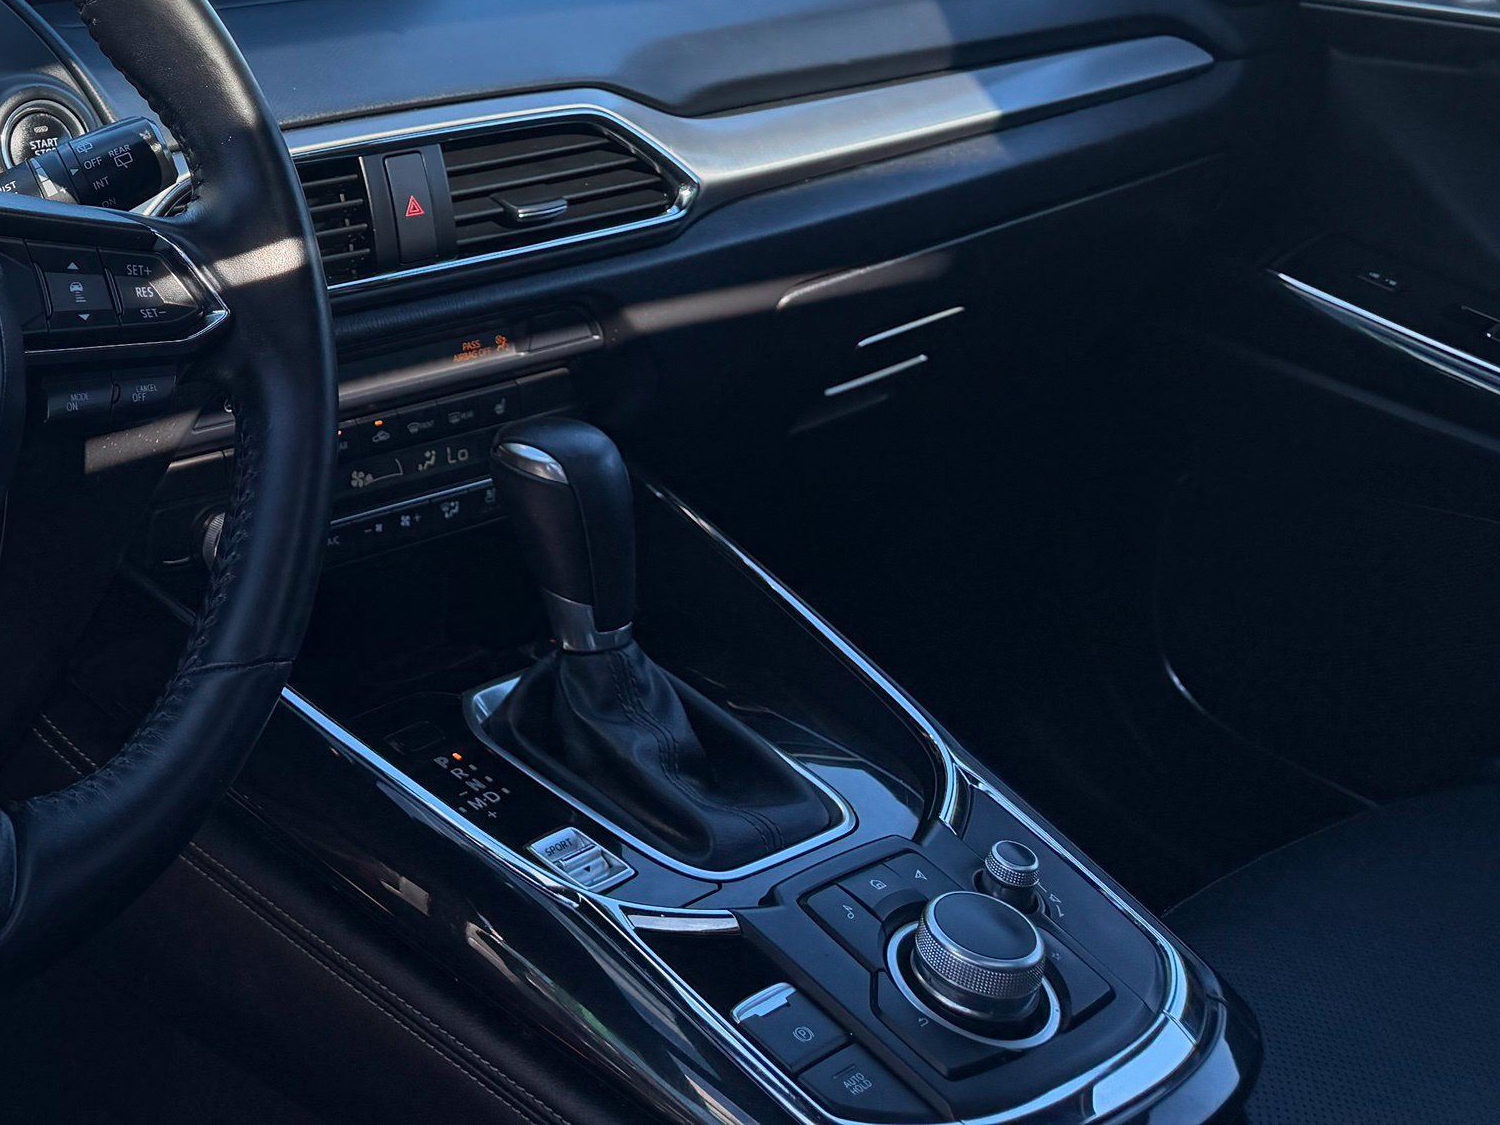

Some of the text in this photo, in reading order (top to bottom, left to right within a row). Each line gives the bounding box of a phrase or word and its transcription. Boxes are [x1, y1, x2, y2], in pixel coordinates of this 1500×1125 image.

[28, 137, 59, 152] START
[108, 143, 132, 158] REAR
[83, 157, 103, 171] OFF
[92, 175, 110, 192] INT
[100, 196, 118, 208] ON
[135, 286, 154, 298] RES
[462, 339, 481, 352] PASS
[135, 383, 159, 393] CANCEL
[70, 391, 90, 402] MODE
[132, 392, 147, 403] OFF
[66, 402, 79, 412] ON
[433, 756, 449, 769] P
[450, 767, 470, 780] R
[464, 778, 487, 792] N
[544, 838, 573, 857] SPORT
[843, 1072, 865, 1089] AUTO
[849, 1079, 873, 1096] HOLD
